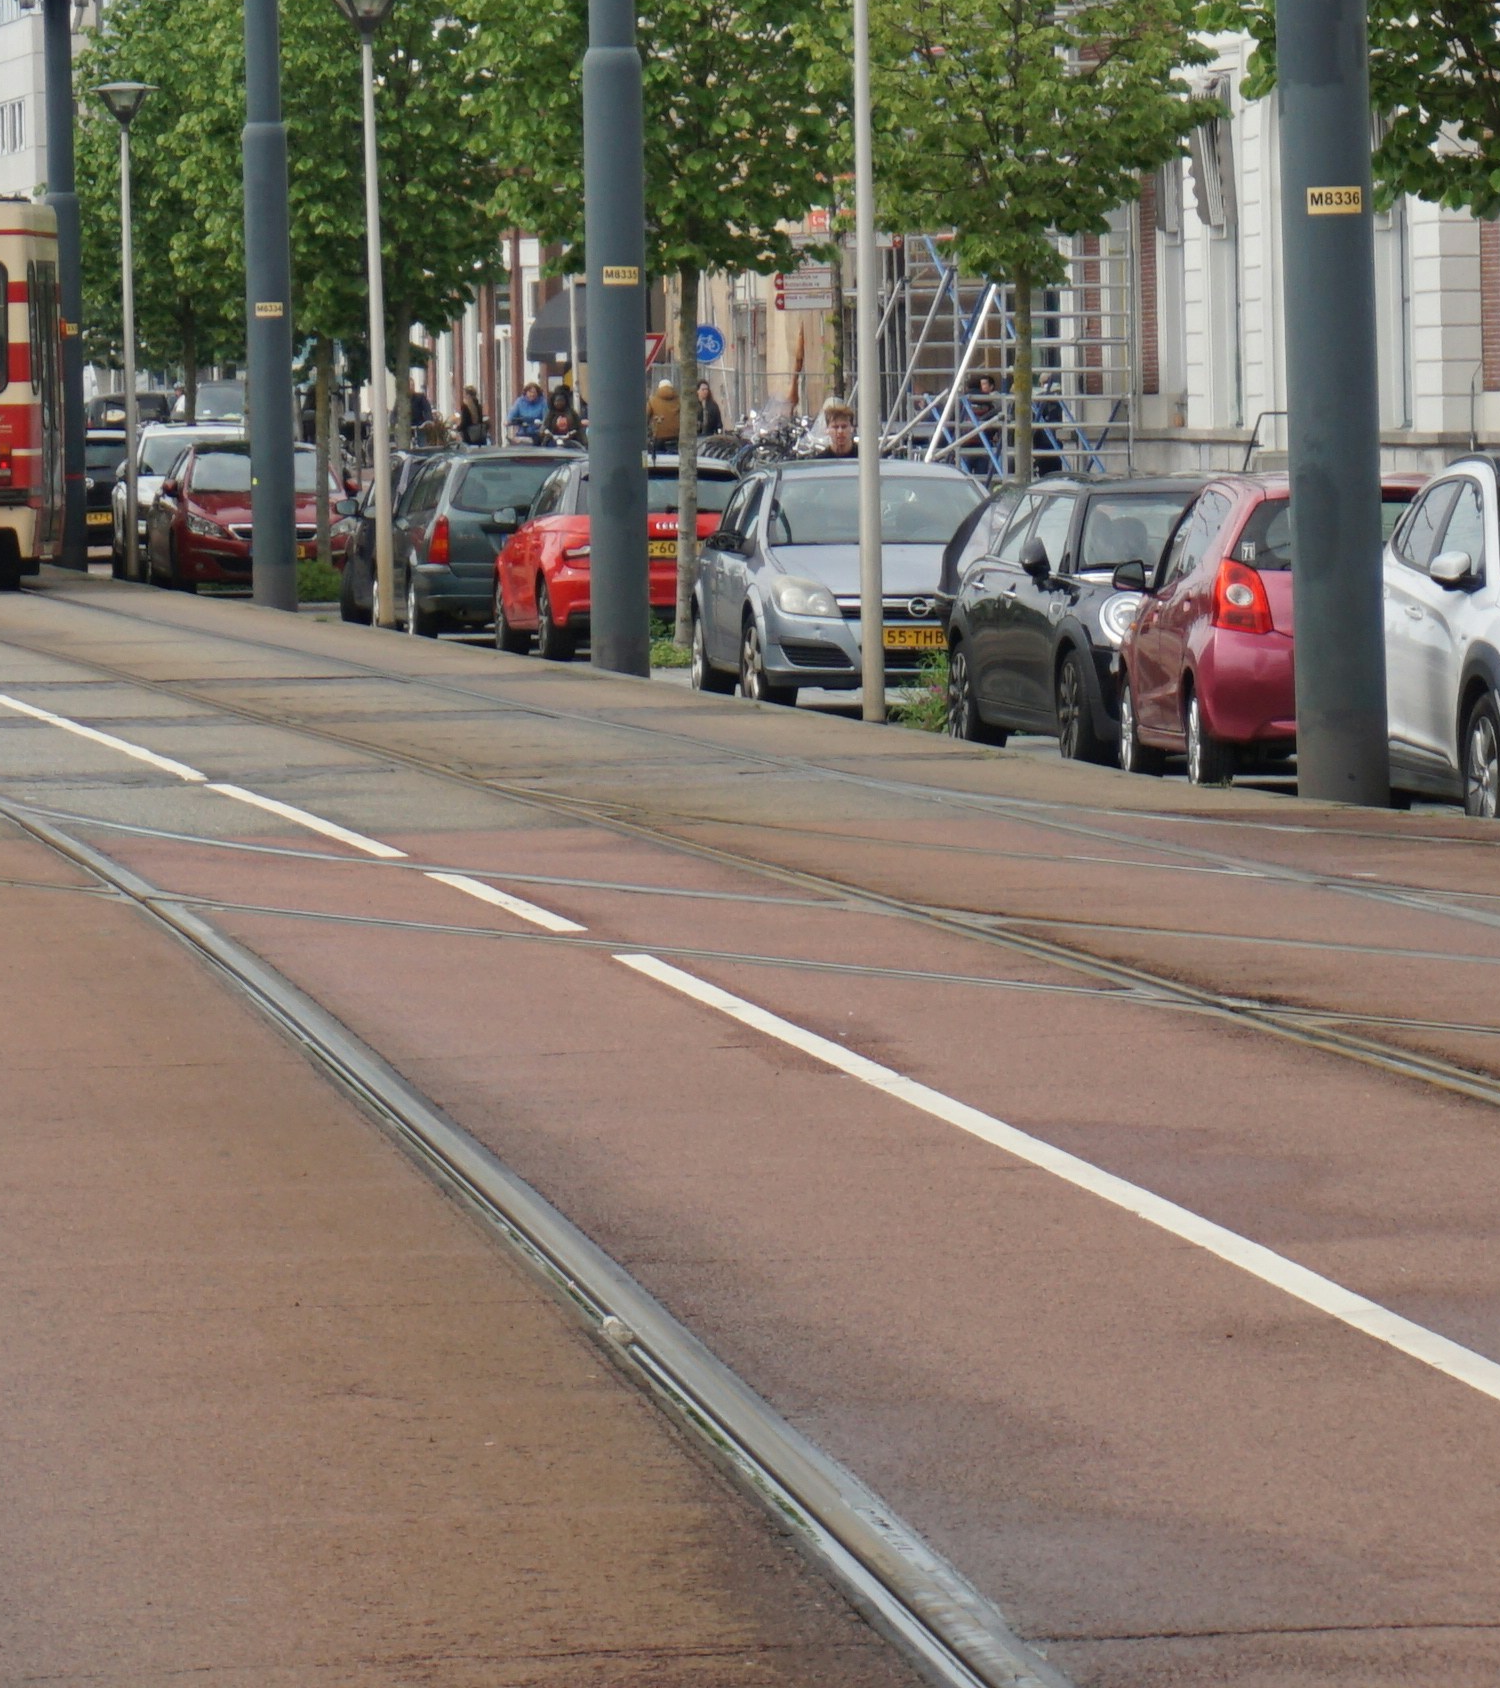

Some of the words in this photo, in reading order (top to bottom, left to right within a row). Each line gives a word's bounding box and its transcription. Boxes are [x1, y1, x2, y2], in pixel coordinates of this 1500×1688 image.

[1310, 191, 1361, 207] M8336
[604, 269, 637, 280] M8335
[887, 629, 945, 644] 55-THB
